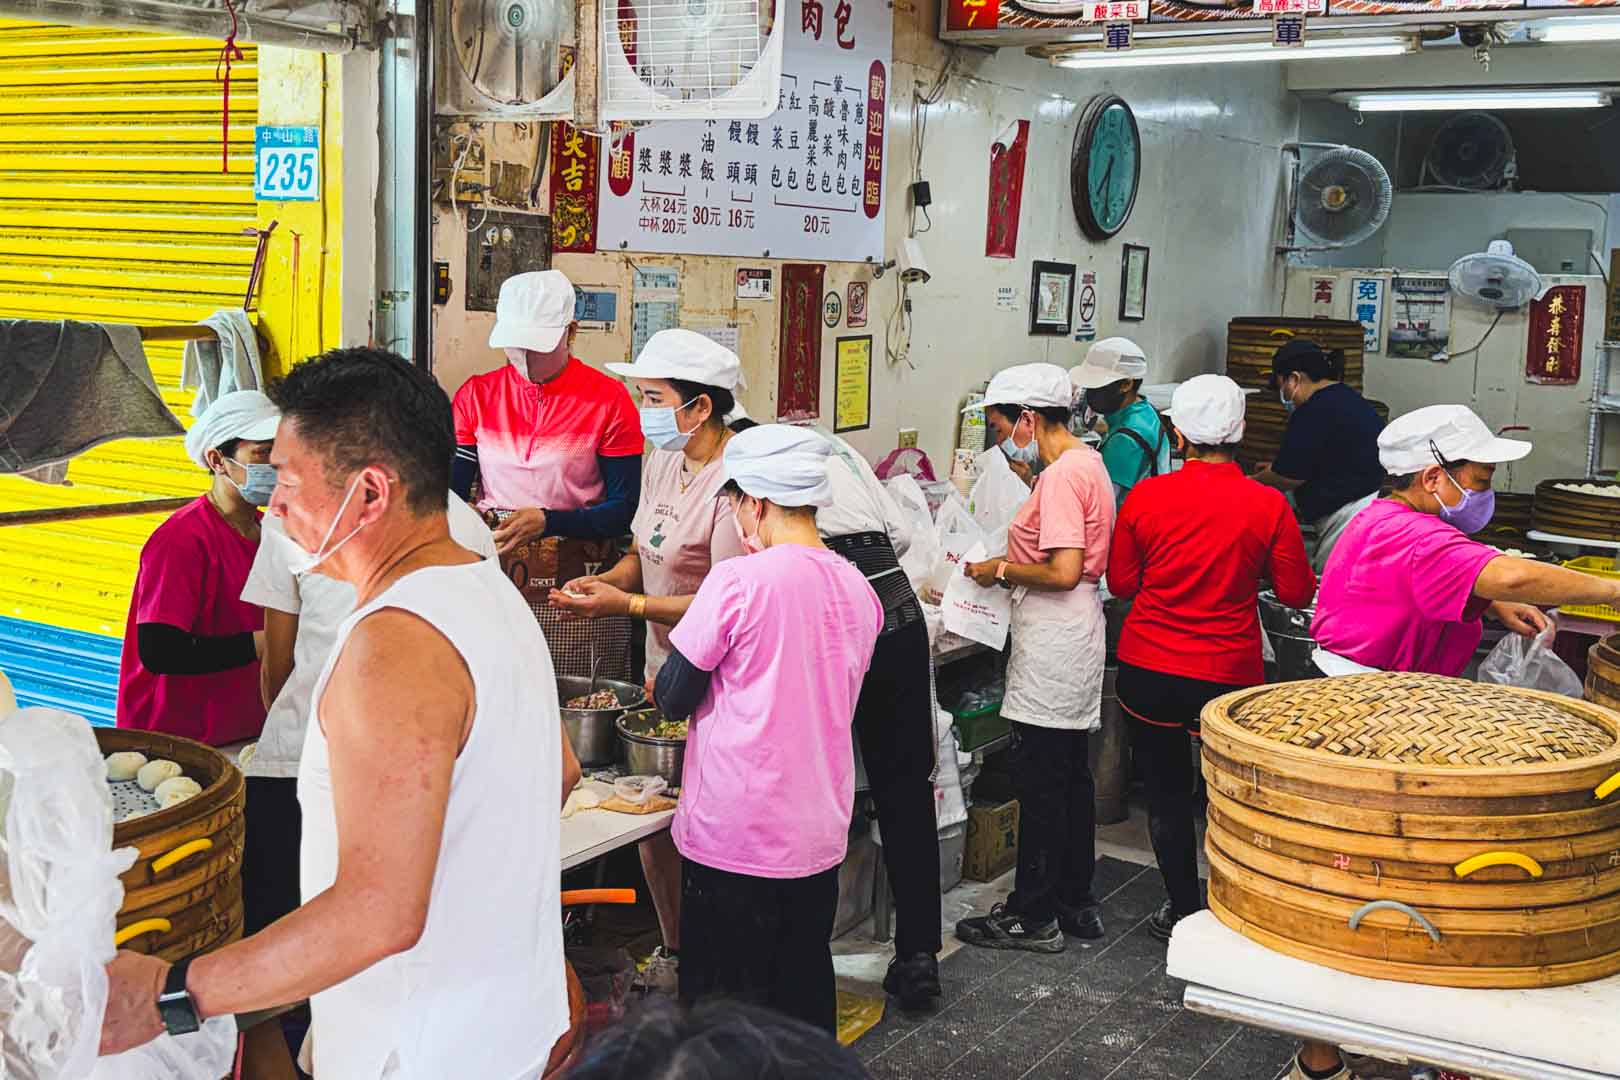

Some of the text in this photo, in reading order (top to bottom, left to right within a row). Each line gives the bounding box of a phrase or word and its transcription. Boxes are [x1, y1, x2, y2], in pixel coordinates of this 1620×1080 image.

[787, 91, 802, 190] 紅豆包
[806, 95, 819, 192] 高麗菜包
[866, 75, 885, 206] 歡迎光臨
[263, 153, 314, 191] 235
[692, 205, 721, 227] 30元
[727, 209, 756, 230] 16元
[803, 214, 831, 235] 20元
